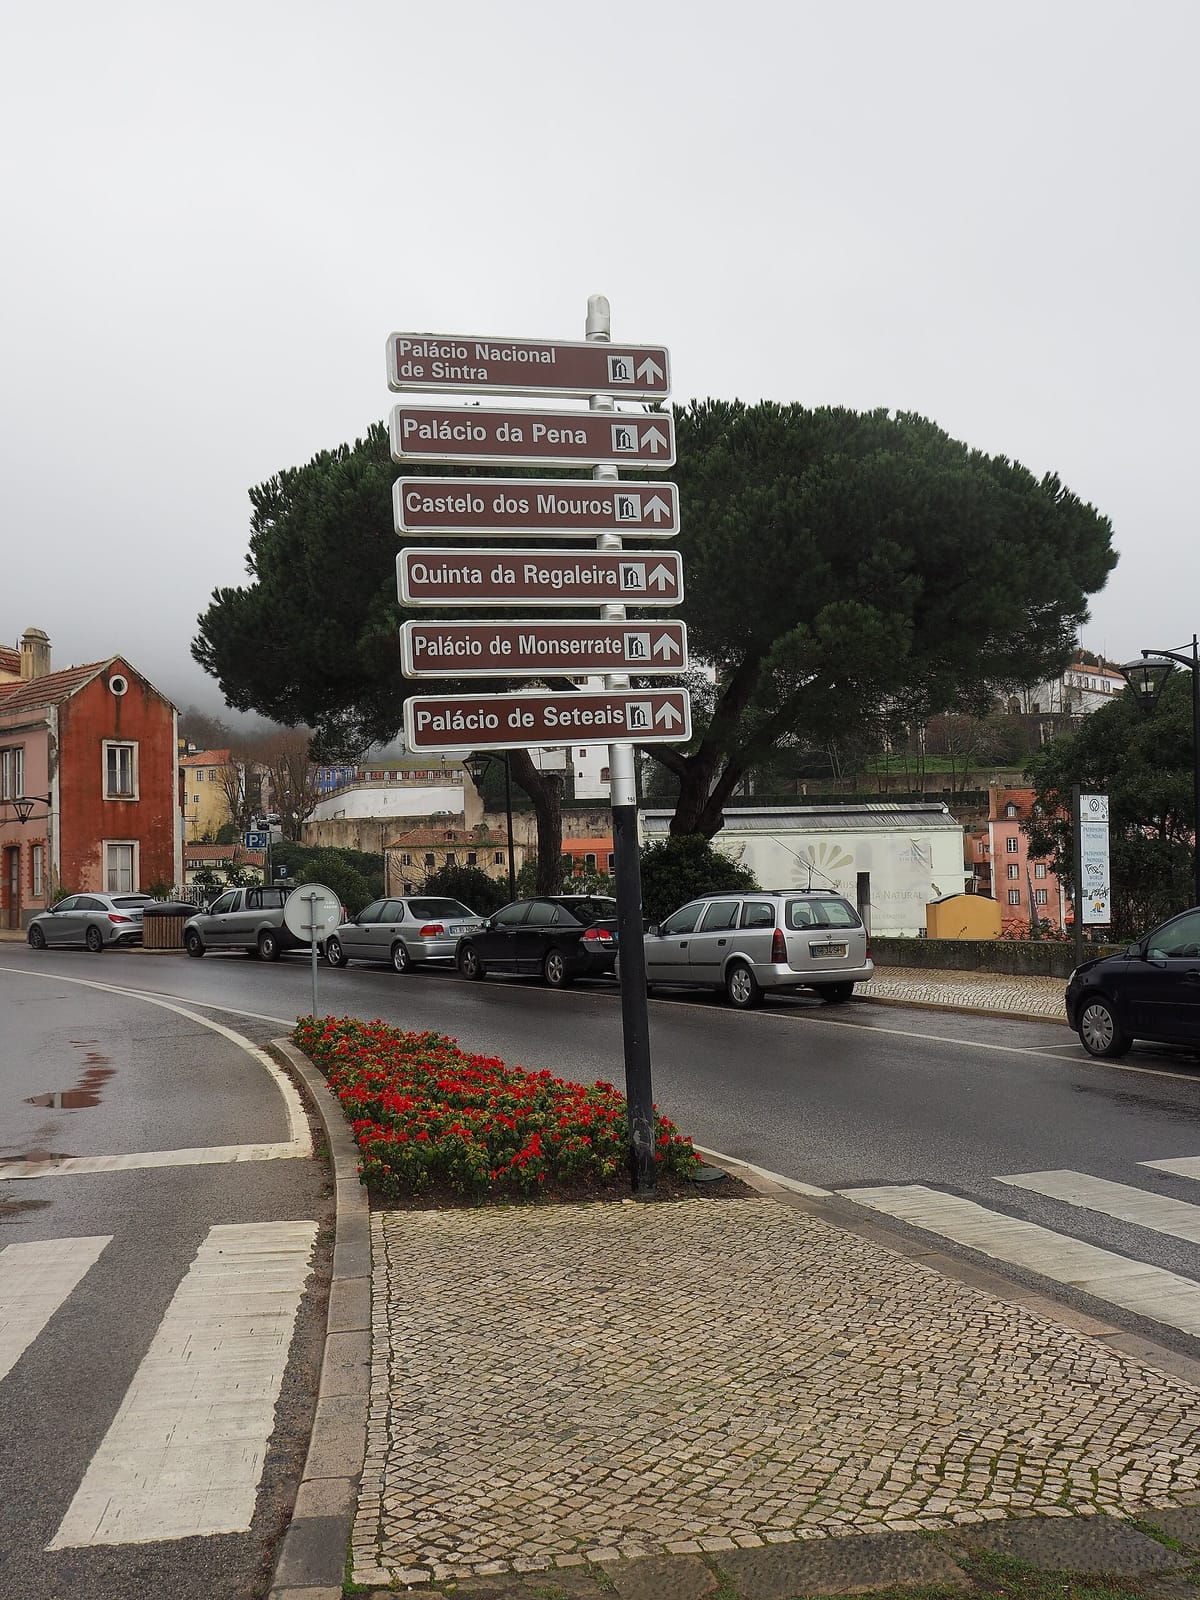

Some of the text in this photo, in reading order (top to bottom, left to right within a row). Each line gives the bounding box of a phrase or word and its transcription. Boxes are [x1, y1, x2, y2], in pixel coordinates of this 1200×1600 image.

[399, 341, 556, 364] Palácio Nacional
[401, 363, 488, 380] de Sintra
[403, 418, 587, 445] Palácio da Pena
[406, 492, 612, 515] Castelo dos Mouros
[411, 564, 617, 589] Quinta da Regaleira
[415, 635, 621, 656] Palácio de Monserrate
[418, 706, 623, 731] Palácio de Seteais
[249, 835, 258, 846] P
[884, 890, 922, 899] NATURAL
